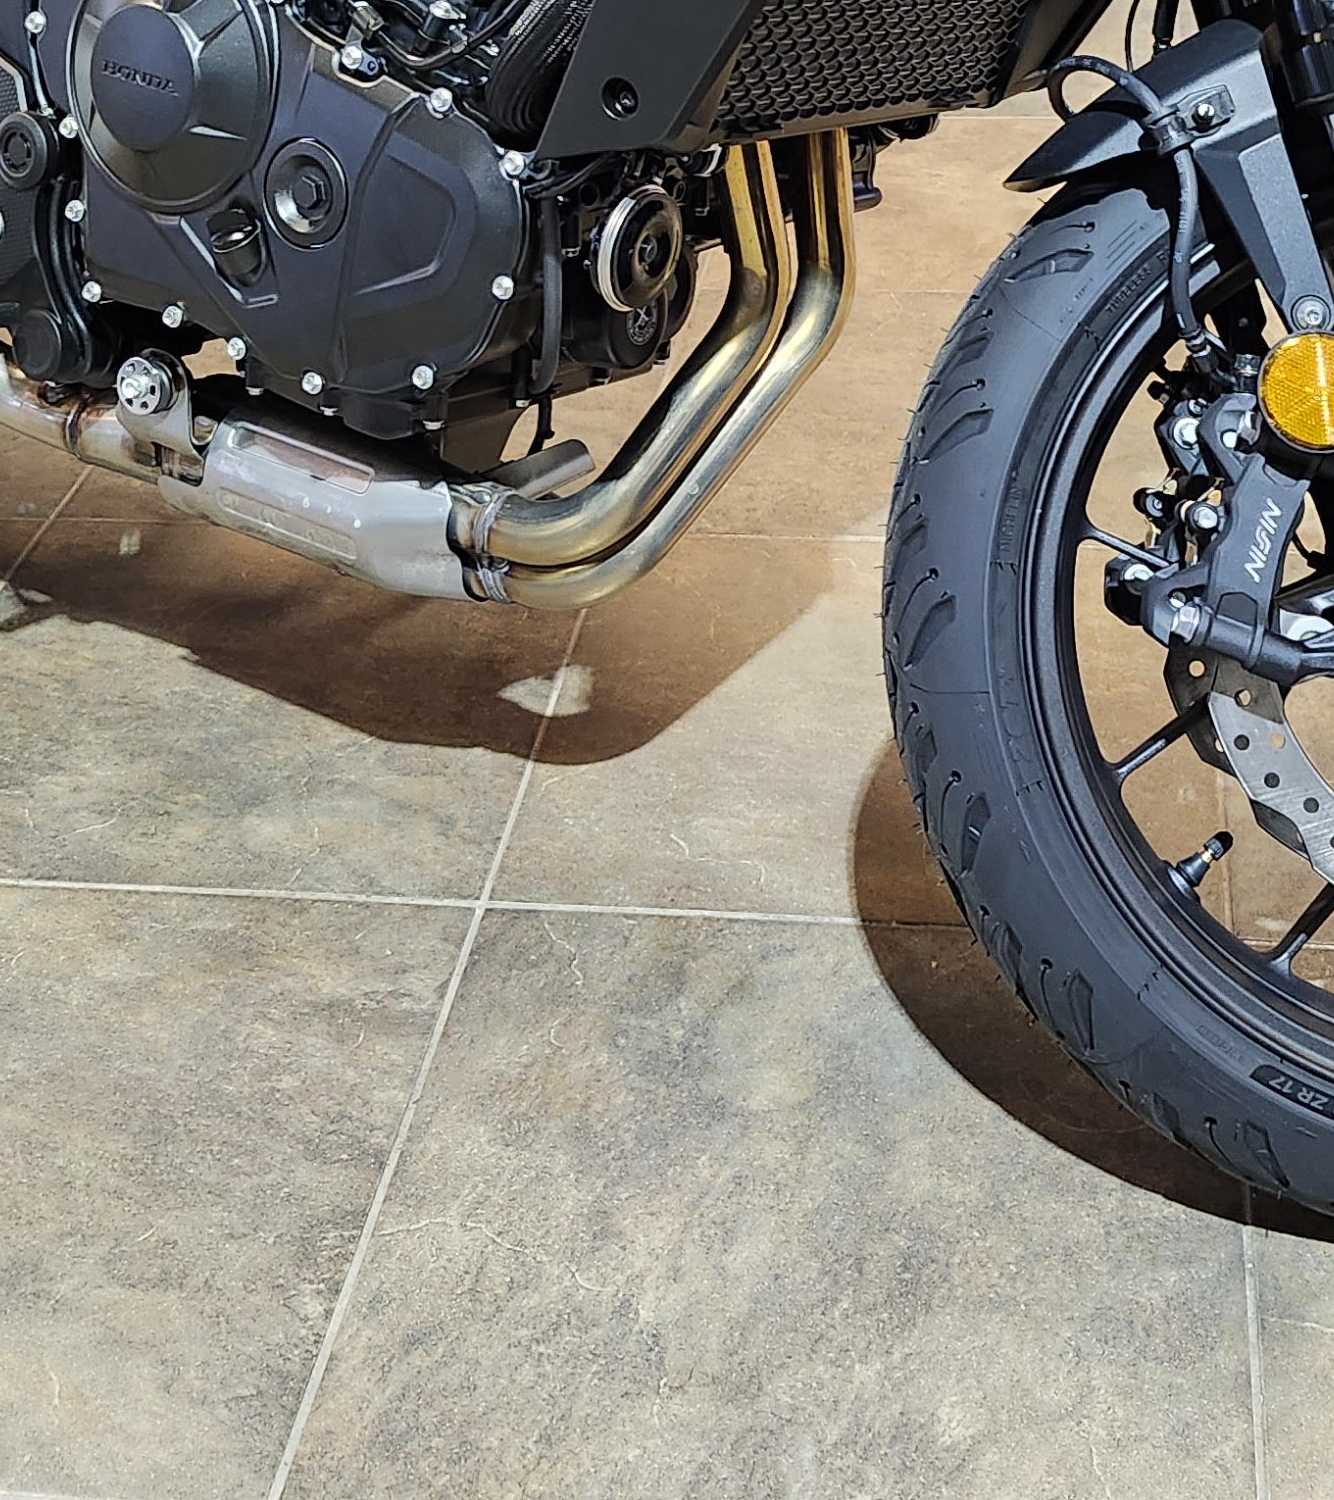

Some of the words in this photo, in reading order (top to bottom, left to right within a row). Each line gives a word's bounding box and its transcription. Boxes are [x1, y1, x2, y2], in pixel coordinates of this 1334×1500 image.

[101, 59, 179, 97] HONDA
[1244, 497, 1282, 583] NISSIN
[1268, 1074, 1294, 1095] 17
[1296, 1087, 1330, 1112] ZR
